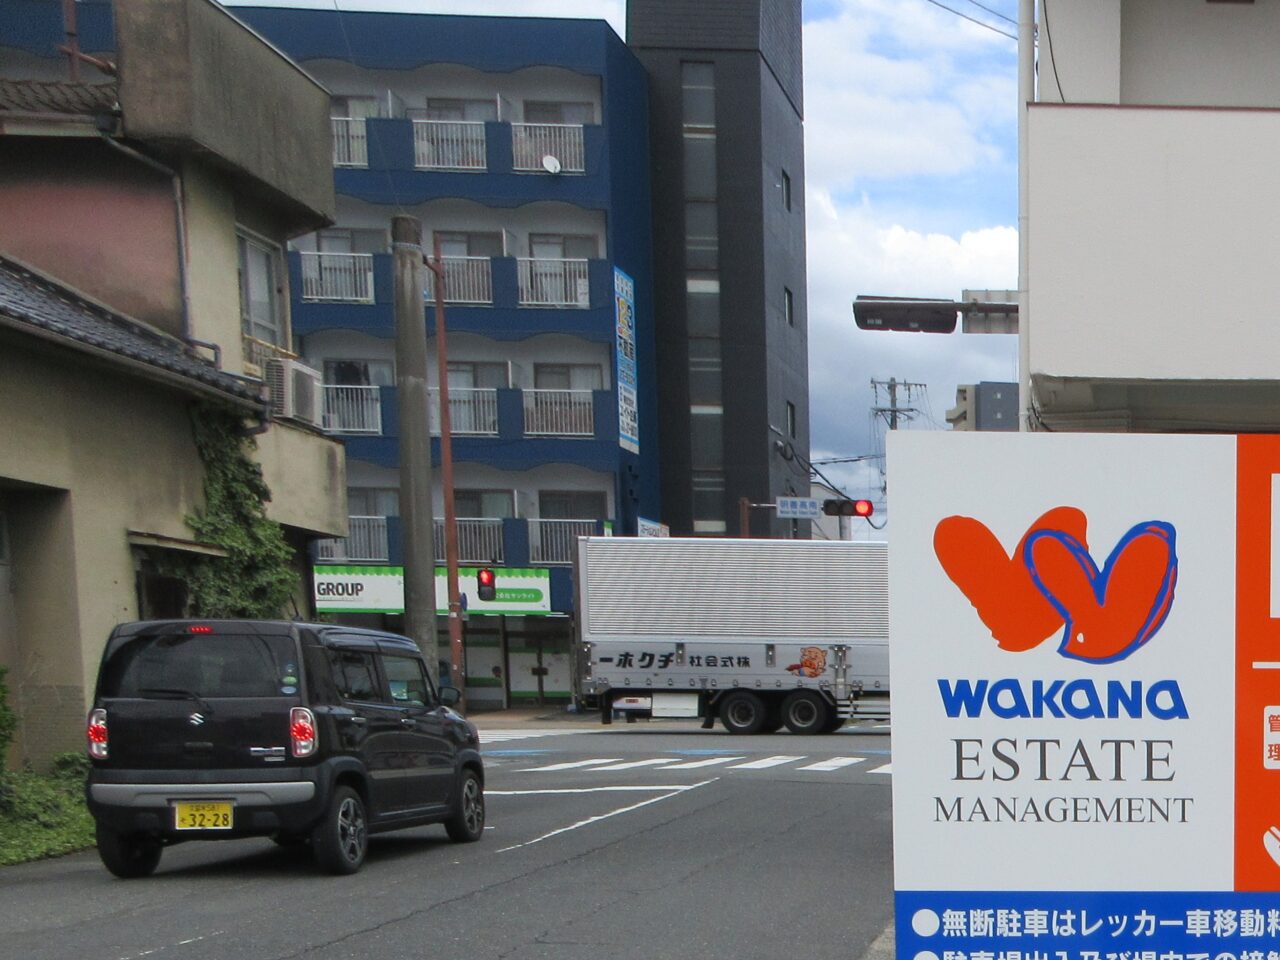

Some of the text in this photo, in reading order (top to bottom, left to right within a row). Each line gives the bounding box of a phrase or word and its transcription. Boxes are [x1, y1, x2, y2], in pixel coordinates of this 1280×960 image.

[317, 582, 364, 597] GROUP
[950, 737, 1176, 782] ESTATE
[189, 813, 230, 827] 32-28
[933, 796, 1194, 823] MANAGEMENT
